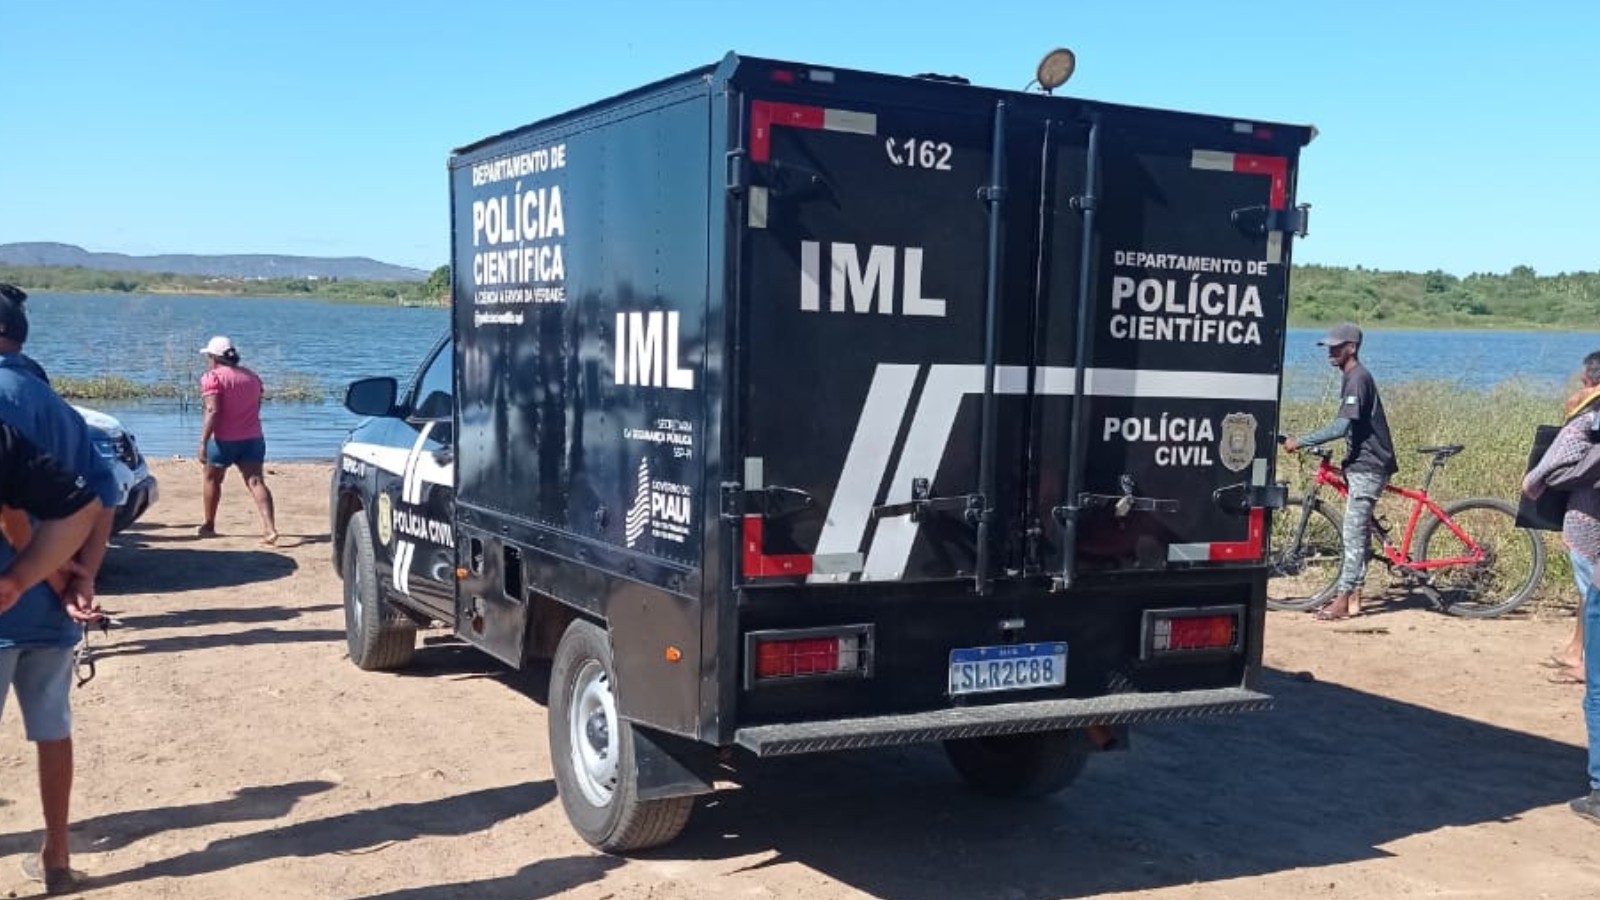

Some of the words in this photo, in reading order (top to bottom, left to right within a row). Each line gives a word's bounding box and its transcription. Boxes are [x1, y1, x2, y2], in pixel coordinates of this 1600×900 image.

[472, 150, 548, 187] DEPARTAMENTO
[550, 144, 566, 169] DE
[904, 138, 952, 171] 162
[473, 181, 565, 246] POLÍCIA
[473, 241, 564, 285] CIENTÍFICA
[801, 240, 946, 317] IML
[1114, 250, 1242, 275] DEPARTAMENTO
[1247, 261, 1268, 276] DE
[1111, 273, 1264, 318] POLÍCIA
[1110, 314, 1262, 345] CIENTÍFICA
[614, 311, 694, 390] IML
[1103, 412, 1214, 442] POLÍCIA
[1155, 446, 1212, 466] CIVIL
[393, 507, 428, 539] POLÍCIA
[428, 518, 455, 548] CIVIL
[962, 658, 1053, 689] SLR2C88
